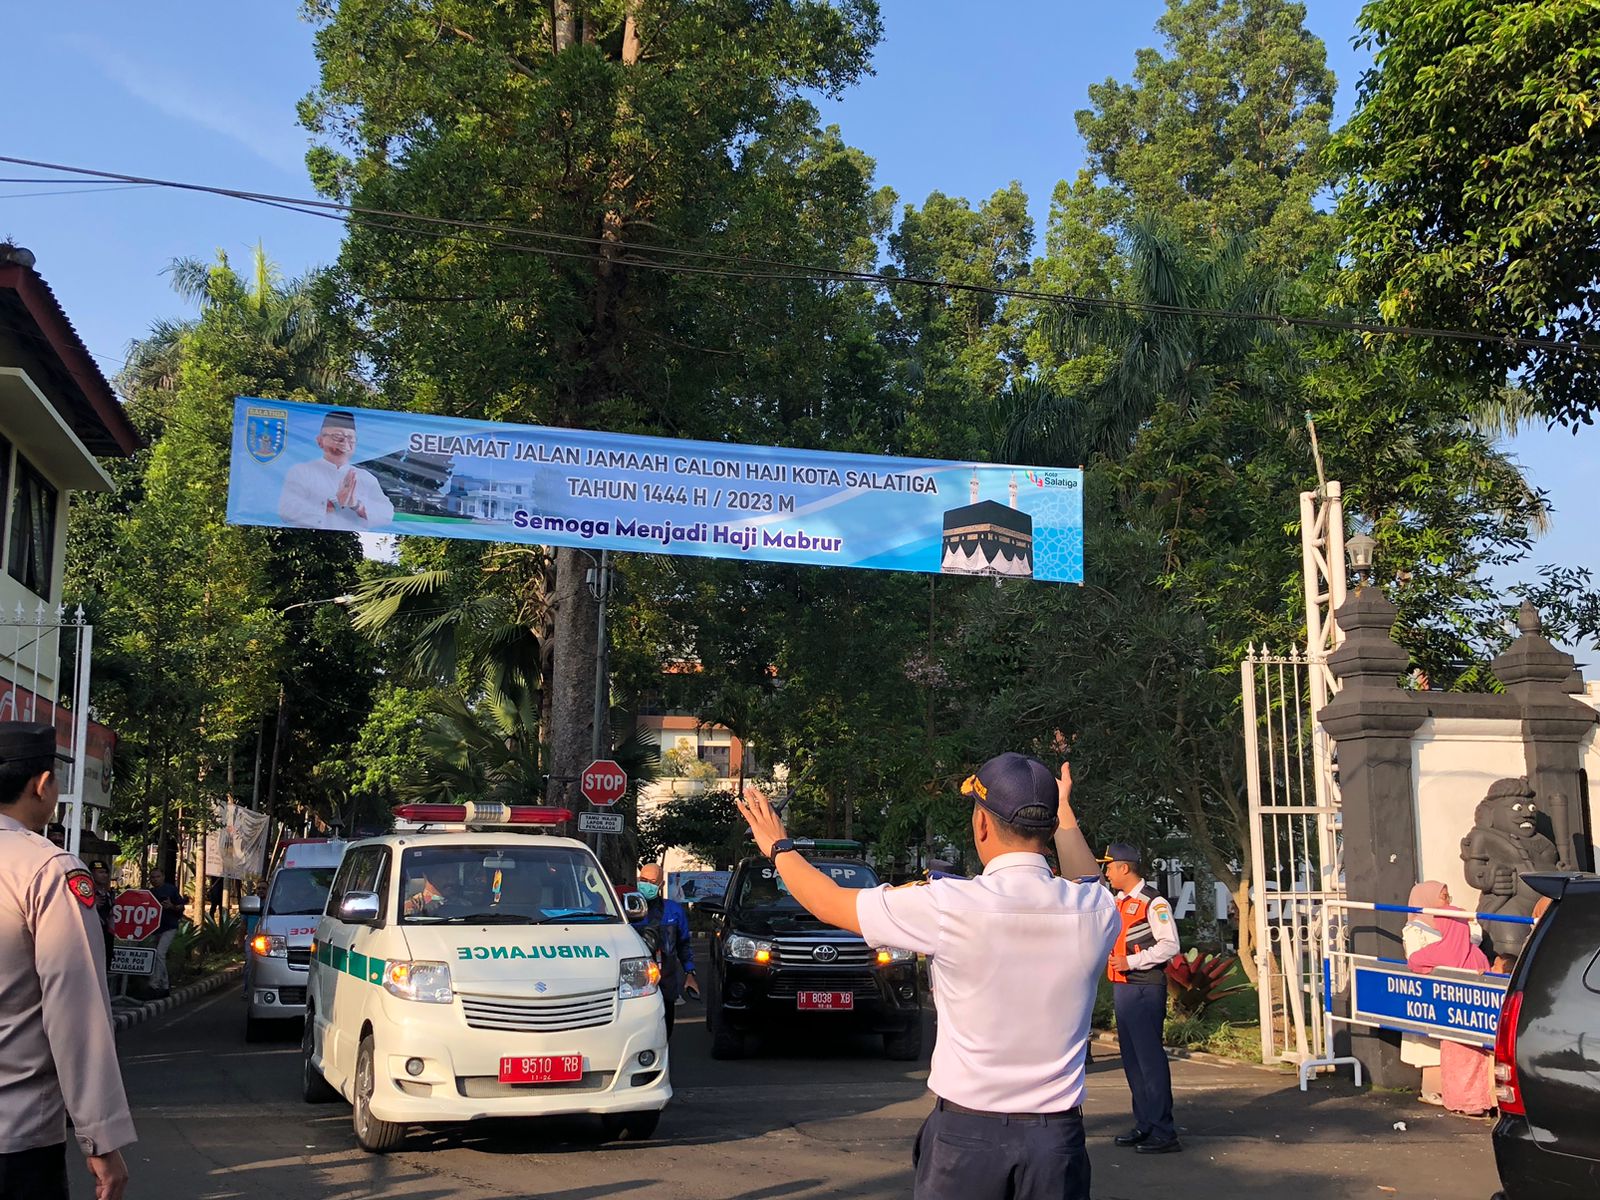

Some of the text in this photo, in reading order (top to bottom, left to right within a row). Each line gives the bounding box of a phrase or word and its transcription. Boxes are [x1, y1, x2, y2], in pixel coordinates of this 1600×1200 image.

[409, 433, 938, 494] SELAMAT JALAN JAMAAH CALON HAJI KOTA SALATIGA
[1044, 477, 1078, 489] Salatiga
[567, 478, 794, 512] TAHUN 1444 H / 2023 M
[513, 510, 842, 551] Semoga Menjadi Haji Mabrur
[585, 774, 624, 790] STOP
[831, 868, 856, 879] PP
[113, 905, 158, 925] STOP
[800, 992, 851, 1004] H 8038 XB
[1387, 976, 1505, 1010] DINAS PERHUBUN
[1406, 1001, 1498, 1031] KOTA SALATIG
[503, 1056, 579, 1075] H 9510 RB
